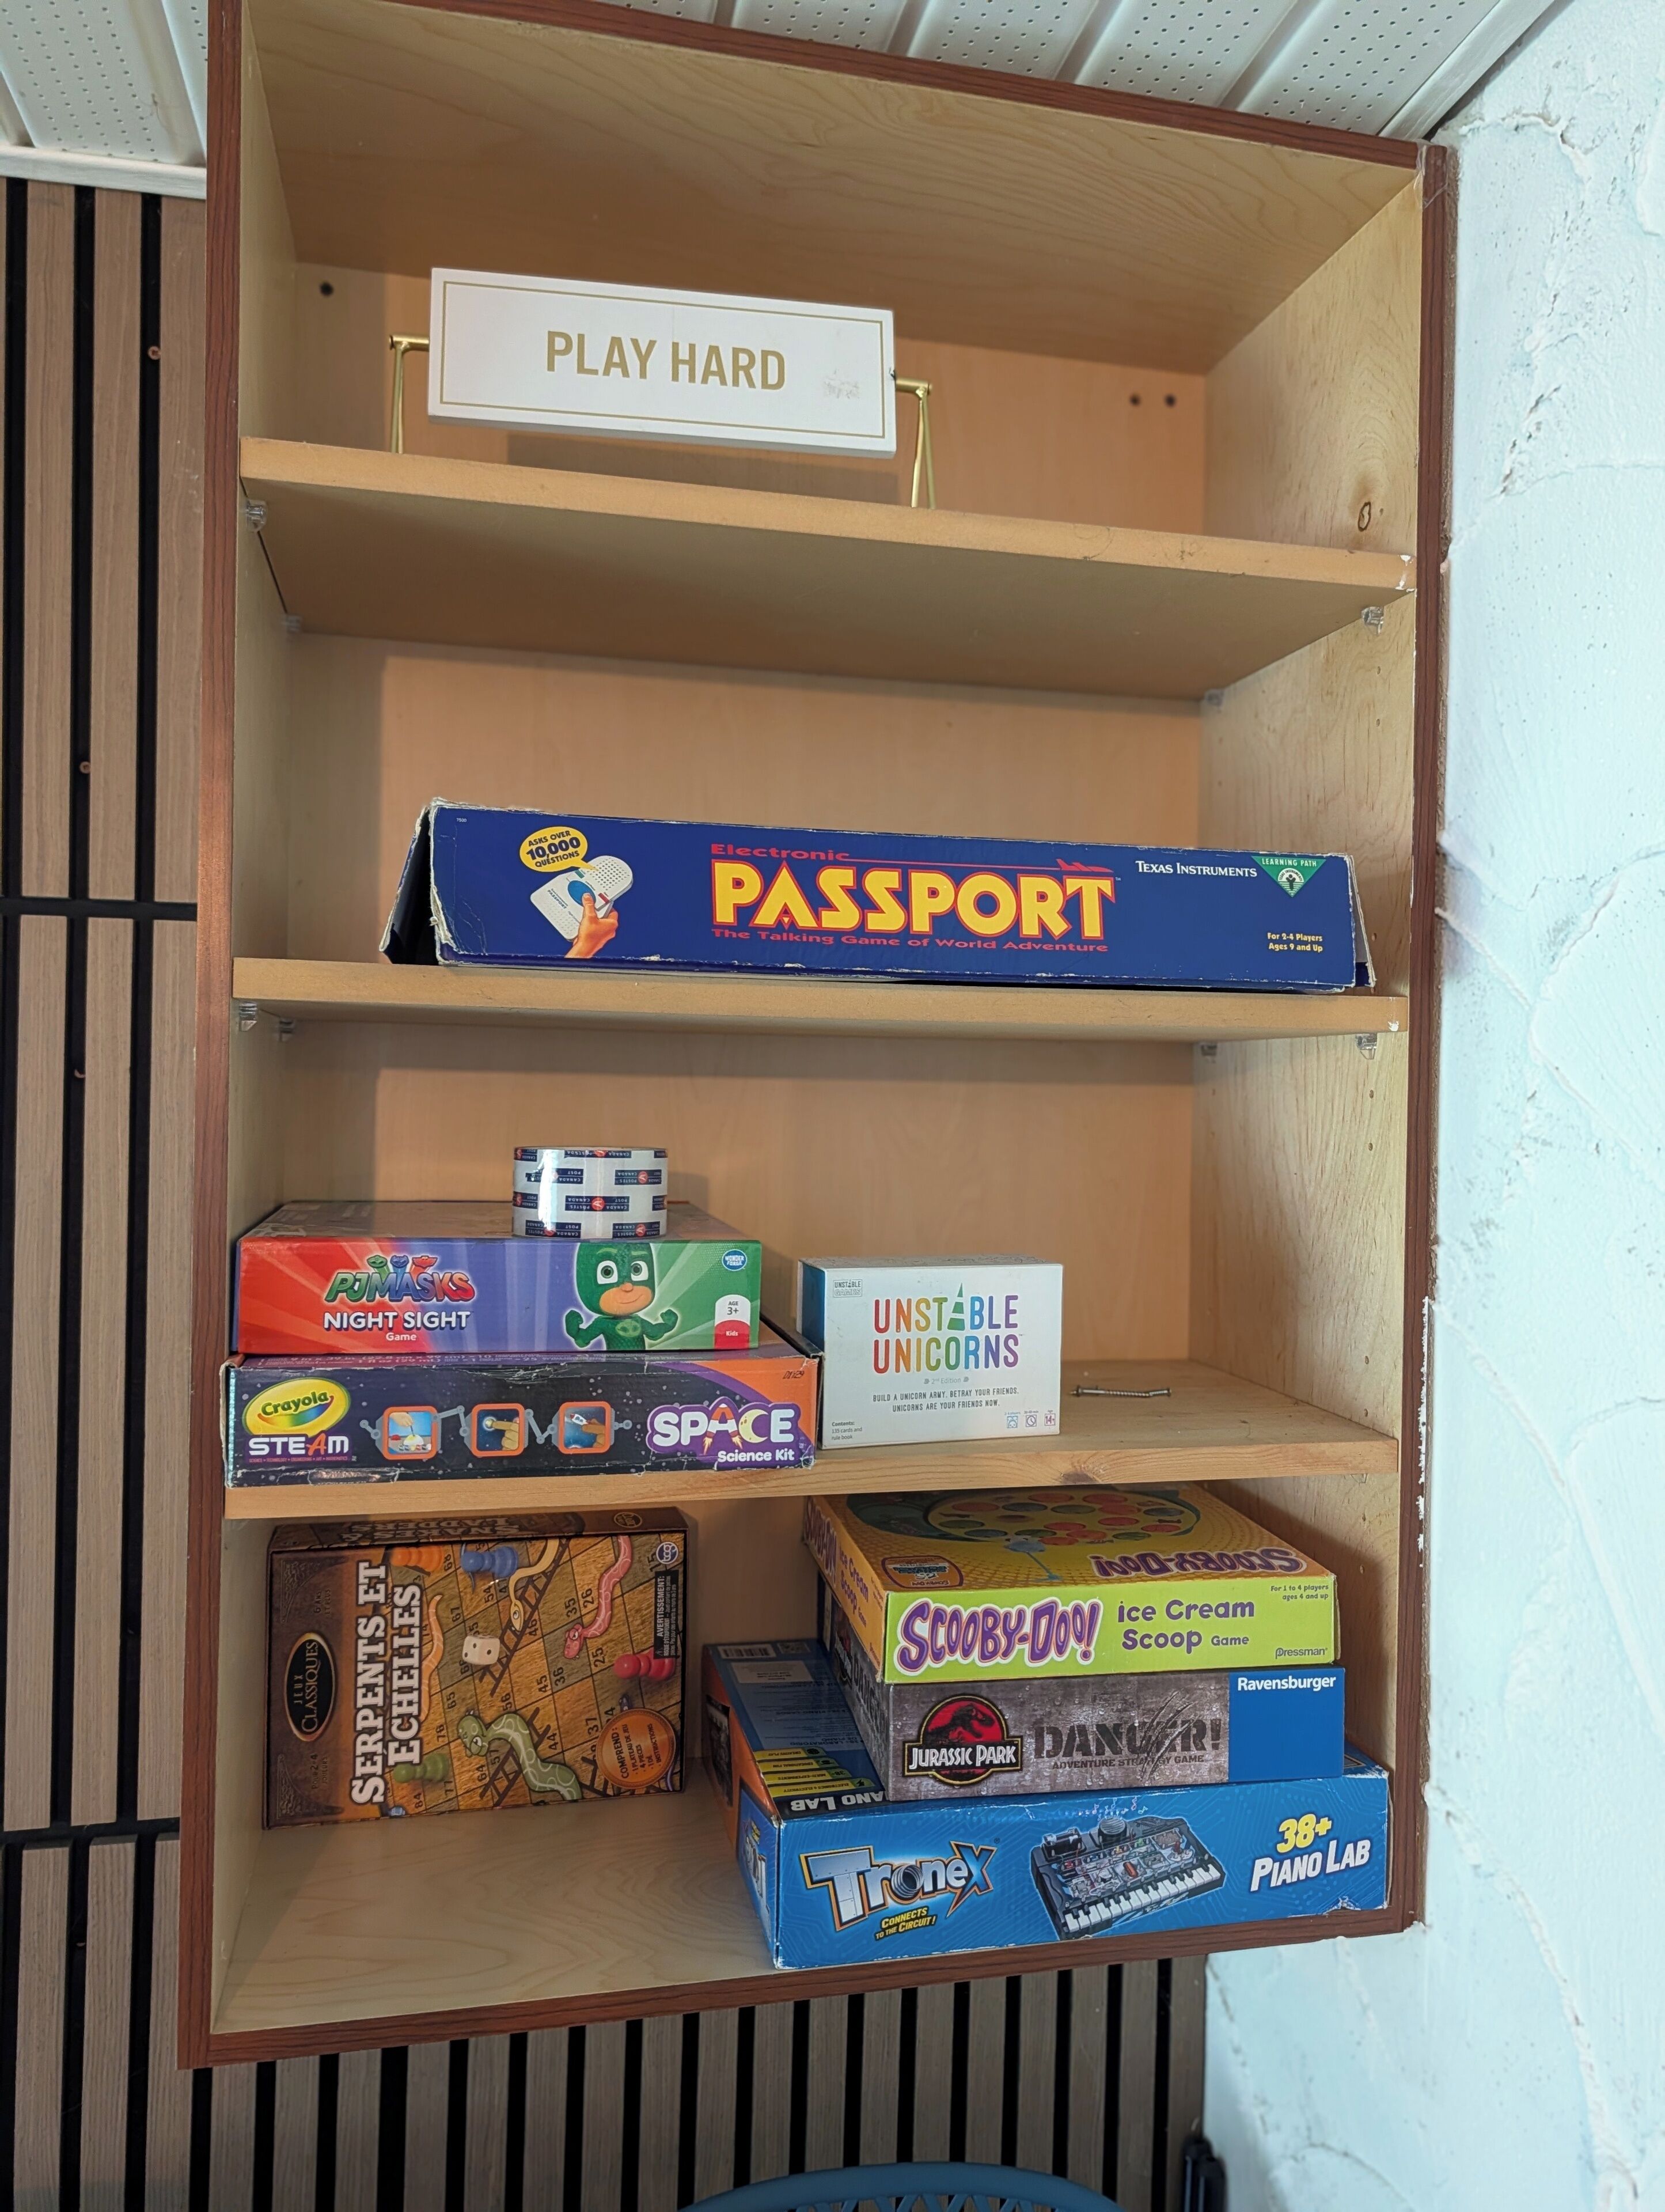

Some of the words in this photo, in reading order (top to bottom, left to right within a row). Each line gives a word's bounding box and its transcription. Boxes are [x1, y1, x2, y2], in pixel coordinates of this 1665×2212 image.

[547, 330, 657, 380] PLAY
[672, 343, 786, 391] HARD
[526, 837, 581, 861] 10,000
[528, 836, 548, 847] ASKS
[550, 831, 571, 840] OVER
[535, 851, 580, 868] QUESTIONS
[711, 844, 849, 861] Electronic
[1262, 858, 1298, 866] LEARNING
[1300, 859, 1317, 867] PATH
[1135, 860, 1173, 873] TEXAS
[1177, 862, 1257, 877] INSTRUMENTS
[711, 859, 1115, 940] PASSPORT
[711, 929, 750, 939] The
[757, 931, 834, 945] Talking
[841, 935, 900, 945] Game
[908, 937, 929, 946] of
[936, 938, 996, 949] World
[1003, 940, 1109, 952] Adventure
[1269, 943, 1287, 952] Ages
[1313, 944, 1323, 953] Up
[1296, 933, 1323, 942] Players
[727, 1306, 739, 1315] 3+
[874, 1282, 1018, 1334] UNSTABLE
[324, 1311, 397, 1331] NIGHT
[403, 1310, 471, 1330] SIGHT
[386, 1332, 417, 1341] Game
[873, 1334, 1019, 1374] UNICORNS
[261, 1391, 329, 1416] Crayola
[900, 1392, 926, 1400] UNICORN
[930, 1391, 947, 1399] ARMY.
[950, 1389, 972, 1397] BETRAY
[974, 1388, 989, 1396] YOUR
[993, 1387, 1019, 1395] FRIENDS.
[893, 1403, 923, 1412] UNICORNS
[940, 1401, 955, 1409] YOUR
[958, 1400, 983, 1408] FRIENDS
[653, 1403, 795, 1449] SPACE
[718, 1449, 772, 1463] Science
[775, 1448, 795, 1461] Kit
[358, 1562, 386, 1605] ET
[1304, 1584, 1329, 1592] players
[484, 1585, 495, 1605] 54
[583, 1588, 596, 1609] 26
[452, 1601, 461, 1622] 67
[566, 1597, 578, 1618] 35
[656, 1576, 665, 1637] AVERTISSEMENT:
[1166, 1600, 1254, 1620] Cream
[528, 1618, 538, 1638] 46
[897, 1599, 1101, 1672] SCOOBY-DOO!
[1122, 1629, 1202, 1654] Scoop
[1211, 1635, 1249, 1647] Game
[591, 1646, 605, 1668] 25
[537, 1676, 549, 1694] 45
[555, 1666, 566, 1687] 36
[1238, 1675, 1337, 1692] Ravensburger
[301, 1642, 320, 1733] CLASSIQUES
[351, 1616, 386, 1804] SERPENTS
[446, 1691, 457, 1710] 65
[586, 1717, 599, 1735] 37
[548, 1732, 559, 1751] 44
[625, 1734, 631, 1743] DE
[647, 1724, 661, 1763] INSTRUCTIONS
[627, 1743, 638, 1767] PLATEAU
[909, 1746, 972, 1770] JURASSIC
[976, 1745, 1017, 1767] PARK
[1052, 1758, 1116, 1770] ADVENTURE
[1174, 1755, 1204, 1764] GAME
[477, 1764, 487, 1782] 64
[791, 1796, 836, 1811] LAB
[1276, 1813, 1332, 1854] 38+
[1250, 1851, 1321, 1892] PIANO
[1325, 1839, 1371, 1874] LAB
[881, 1907, 928, 1929] CONNECTS
[885, 1927, 897, 1936] THE
[898, 1915, 936, 1933] CIRCUIT!
